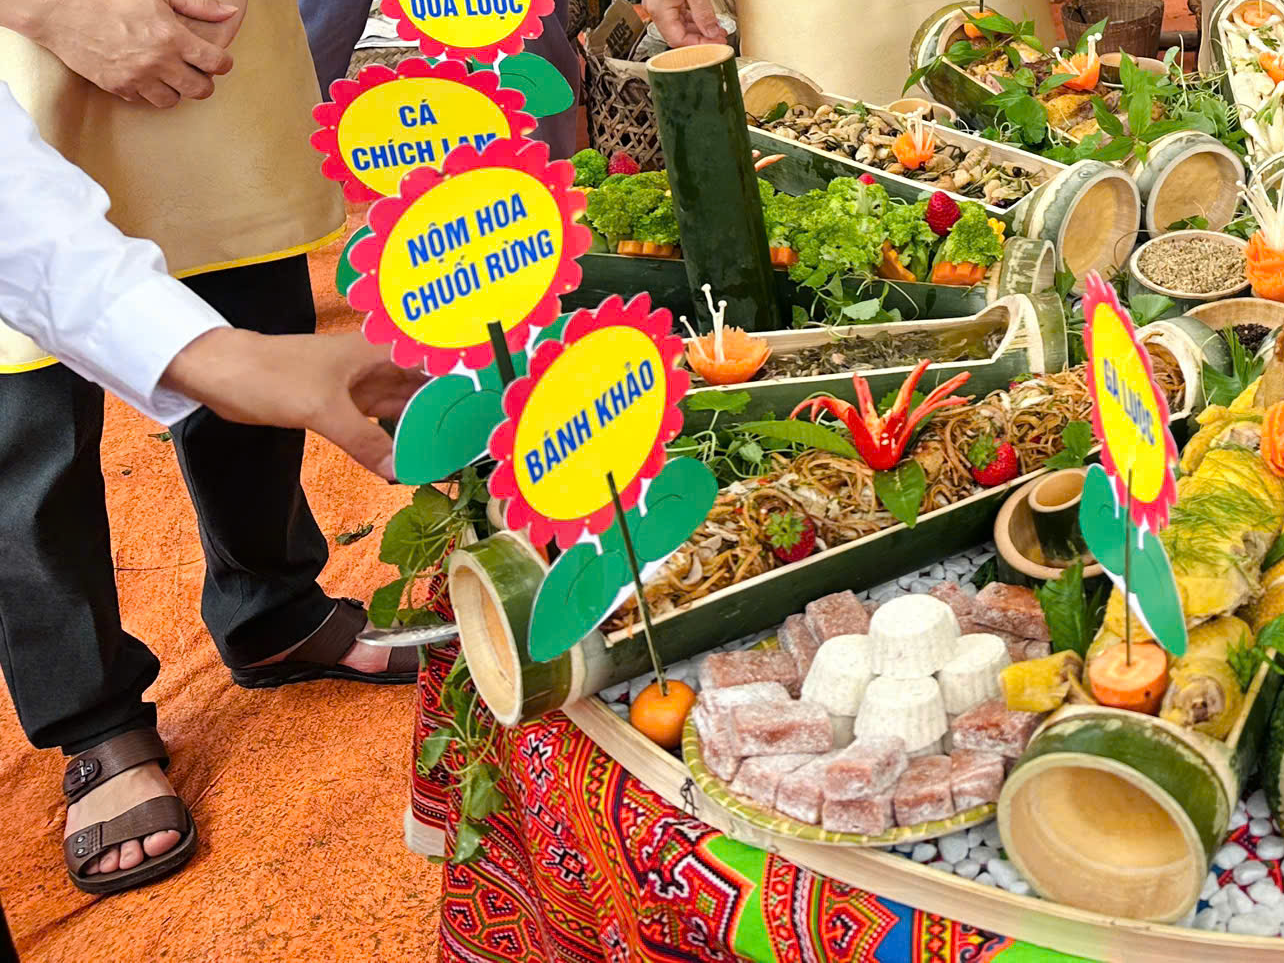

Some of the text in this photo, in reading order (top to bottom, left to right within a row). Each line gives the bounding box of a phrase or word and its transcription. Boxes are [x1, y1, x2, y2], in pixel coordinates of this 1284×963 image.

[398, 98, 437, 128] CÁ
[351, 139, 436, 172] CHÍCH
[406, 192, 528, 268] NỘM HOA
[401, 228, 556, 322] CHUỐI RỪNG
[524, 358, 656, 485] BÁNH KHẢO
